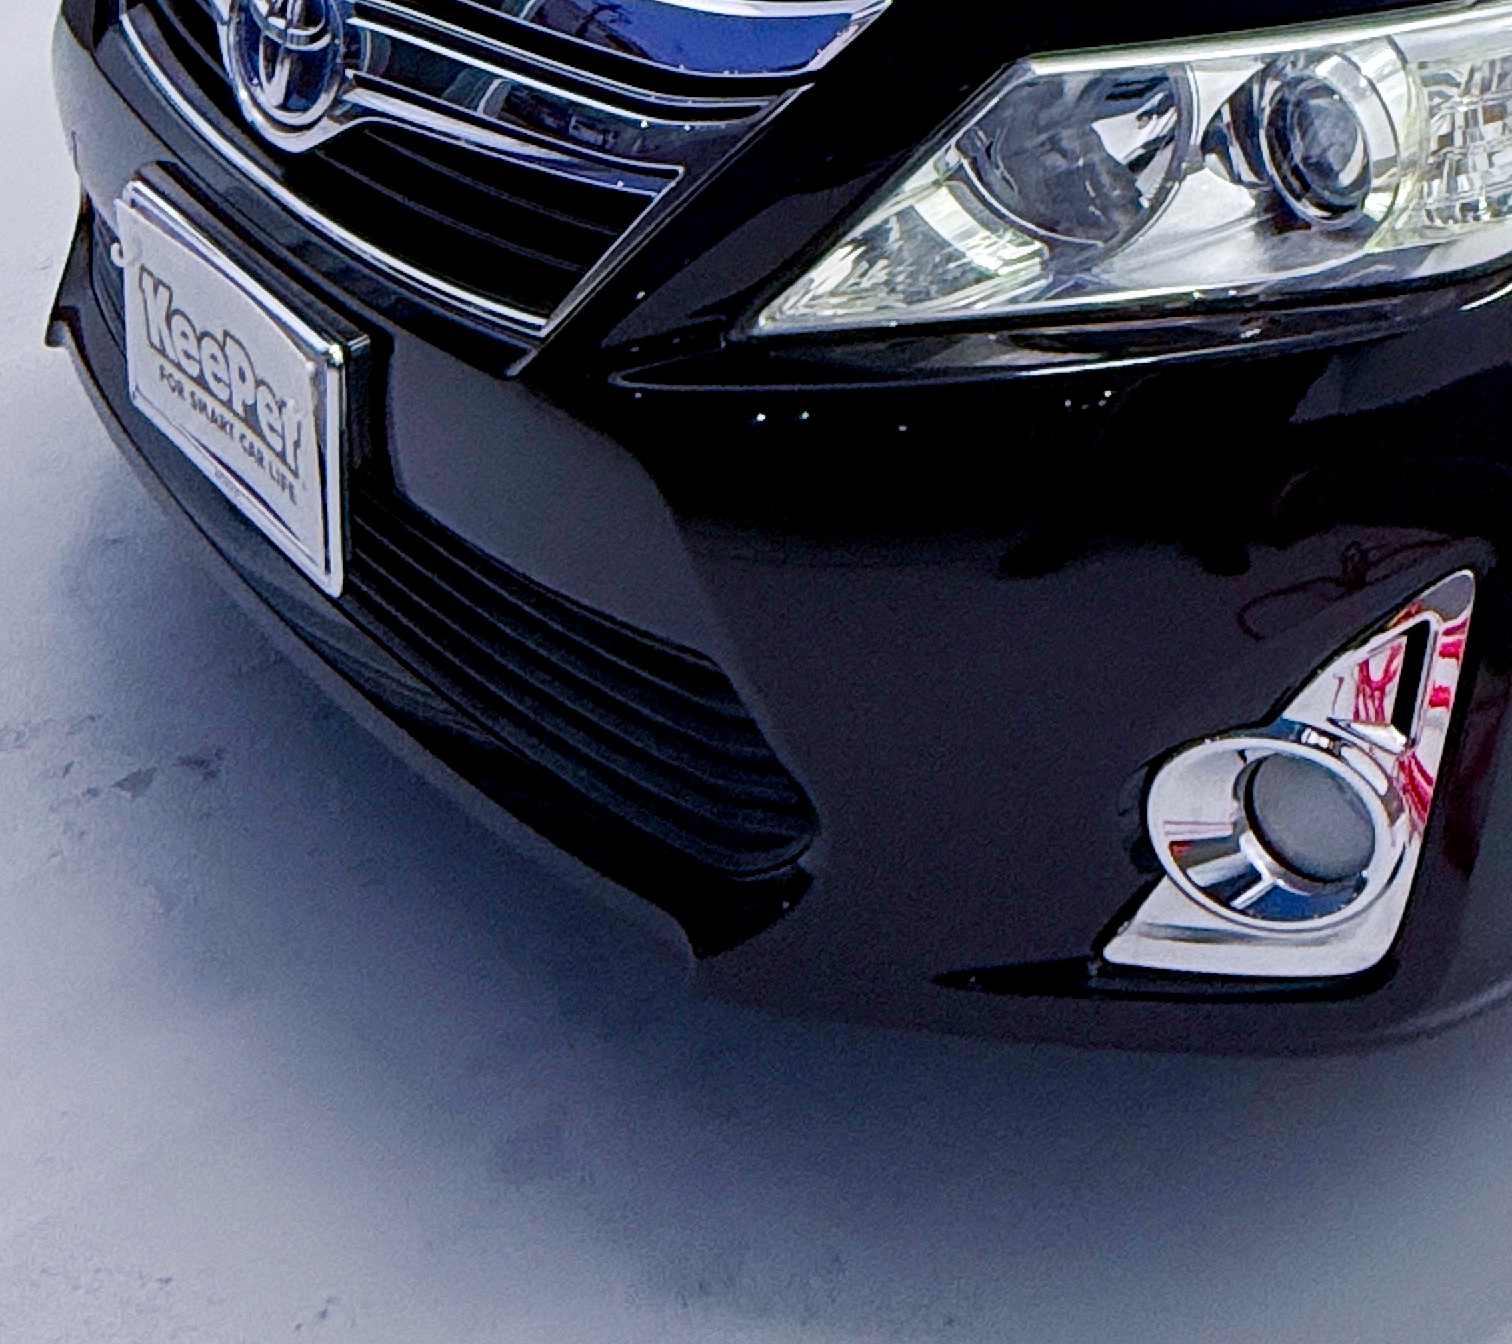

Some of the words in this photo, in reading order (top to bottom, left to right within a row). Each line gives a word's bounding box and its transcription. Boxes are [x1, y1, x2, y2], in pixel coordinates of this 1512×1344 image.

[139, 263, 302, 481] KeePer
[159, 363, 185, 400] FOR
[190, 389, 235, 441] SMART
[238, 431, 265, 470] CAR
[268, 463, 297, 506] LIFE
